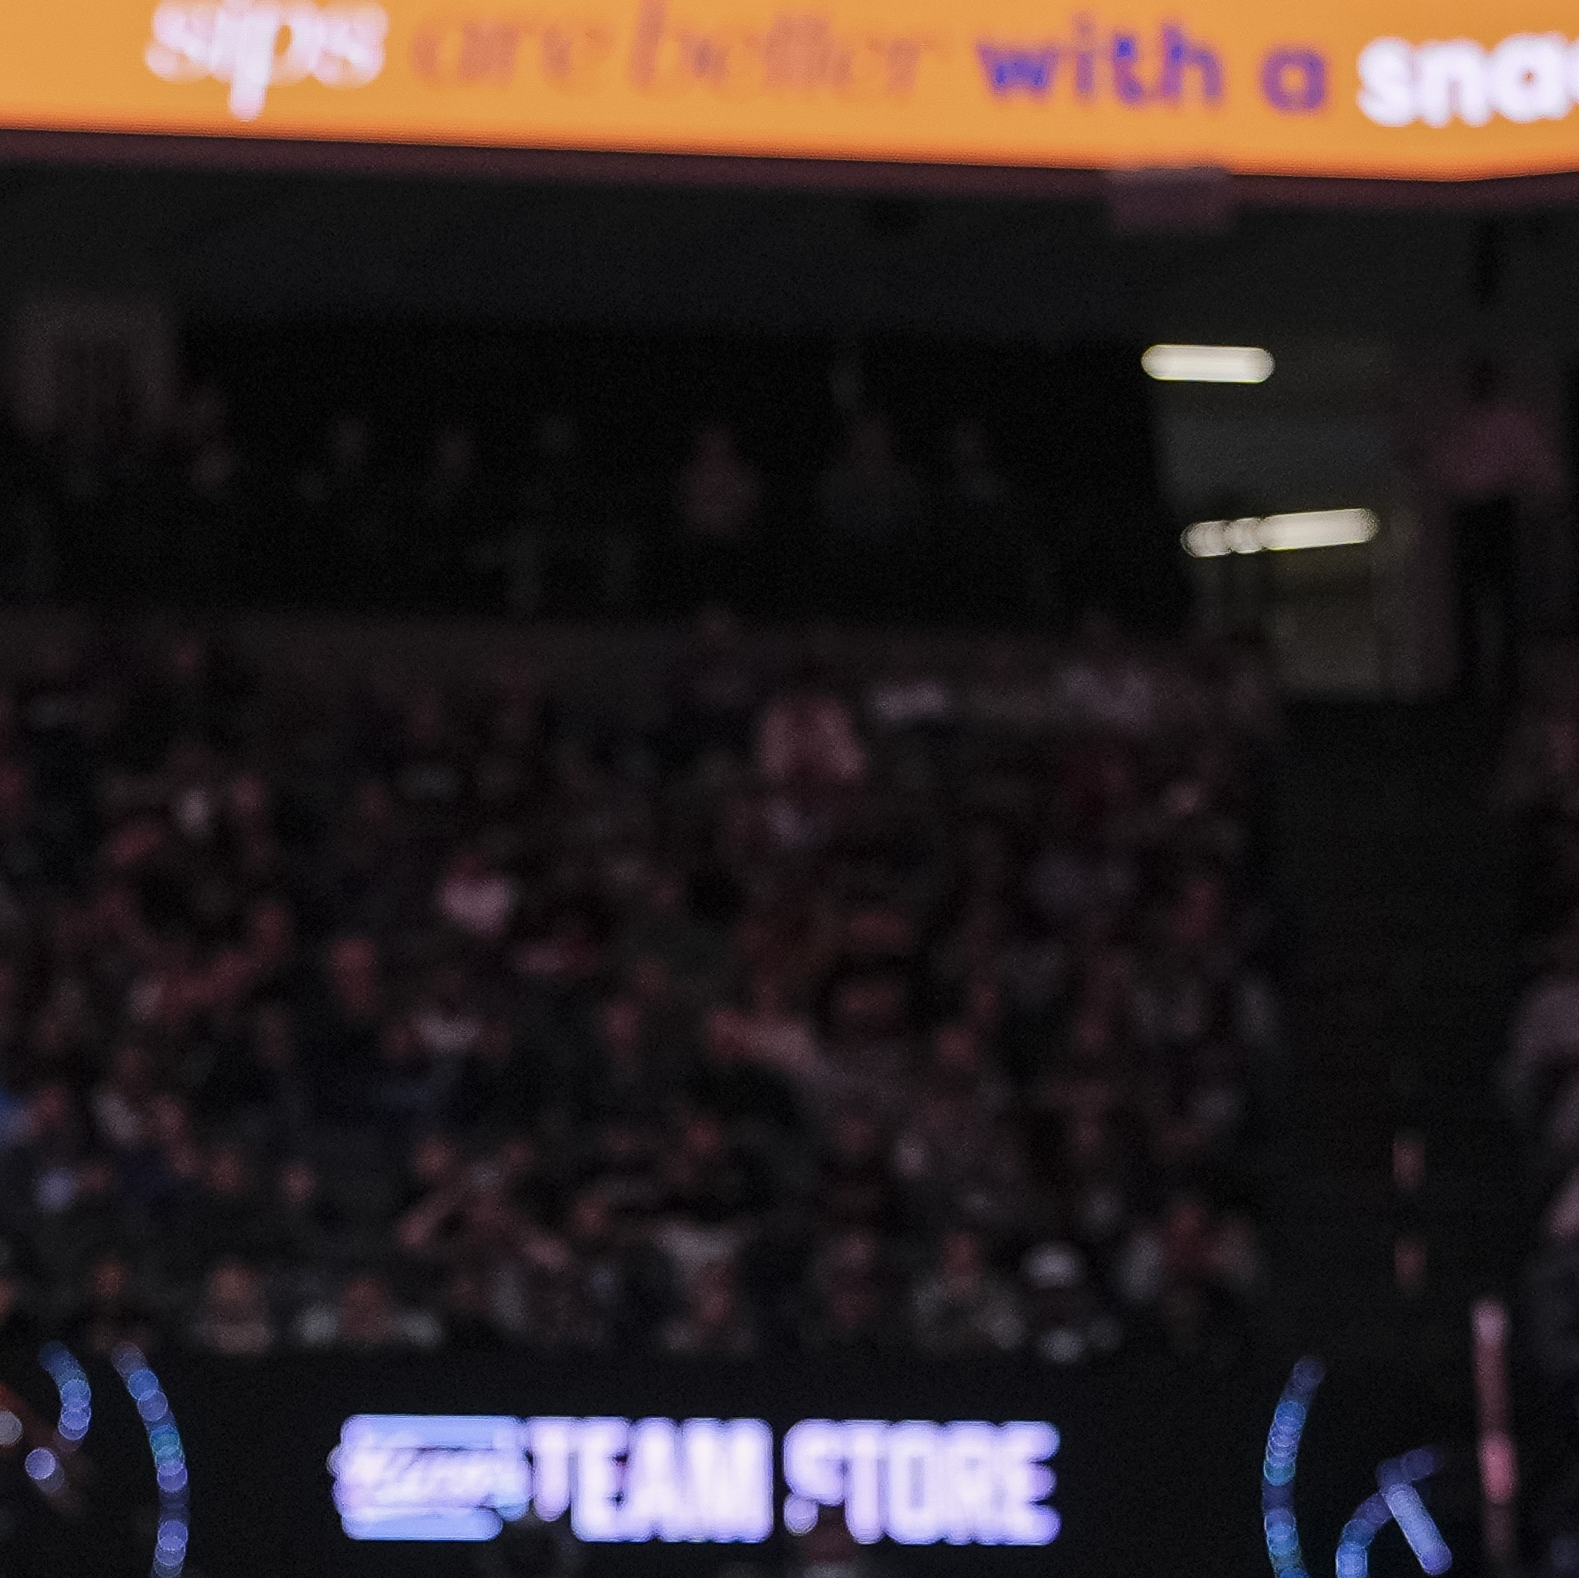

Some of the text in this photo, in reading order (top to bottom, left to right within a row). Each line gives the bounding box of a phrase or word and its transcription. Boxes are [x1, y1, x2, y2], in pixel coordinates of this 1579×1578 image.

[974, 10, 1226, 112] with
[1257, 42, 1331, 116] a
[1356, 31, 1579, 128] sna
[523, 1415, 774, 1544] TEAM
[783, 1417, 1062, 1546] STORE
